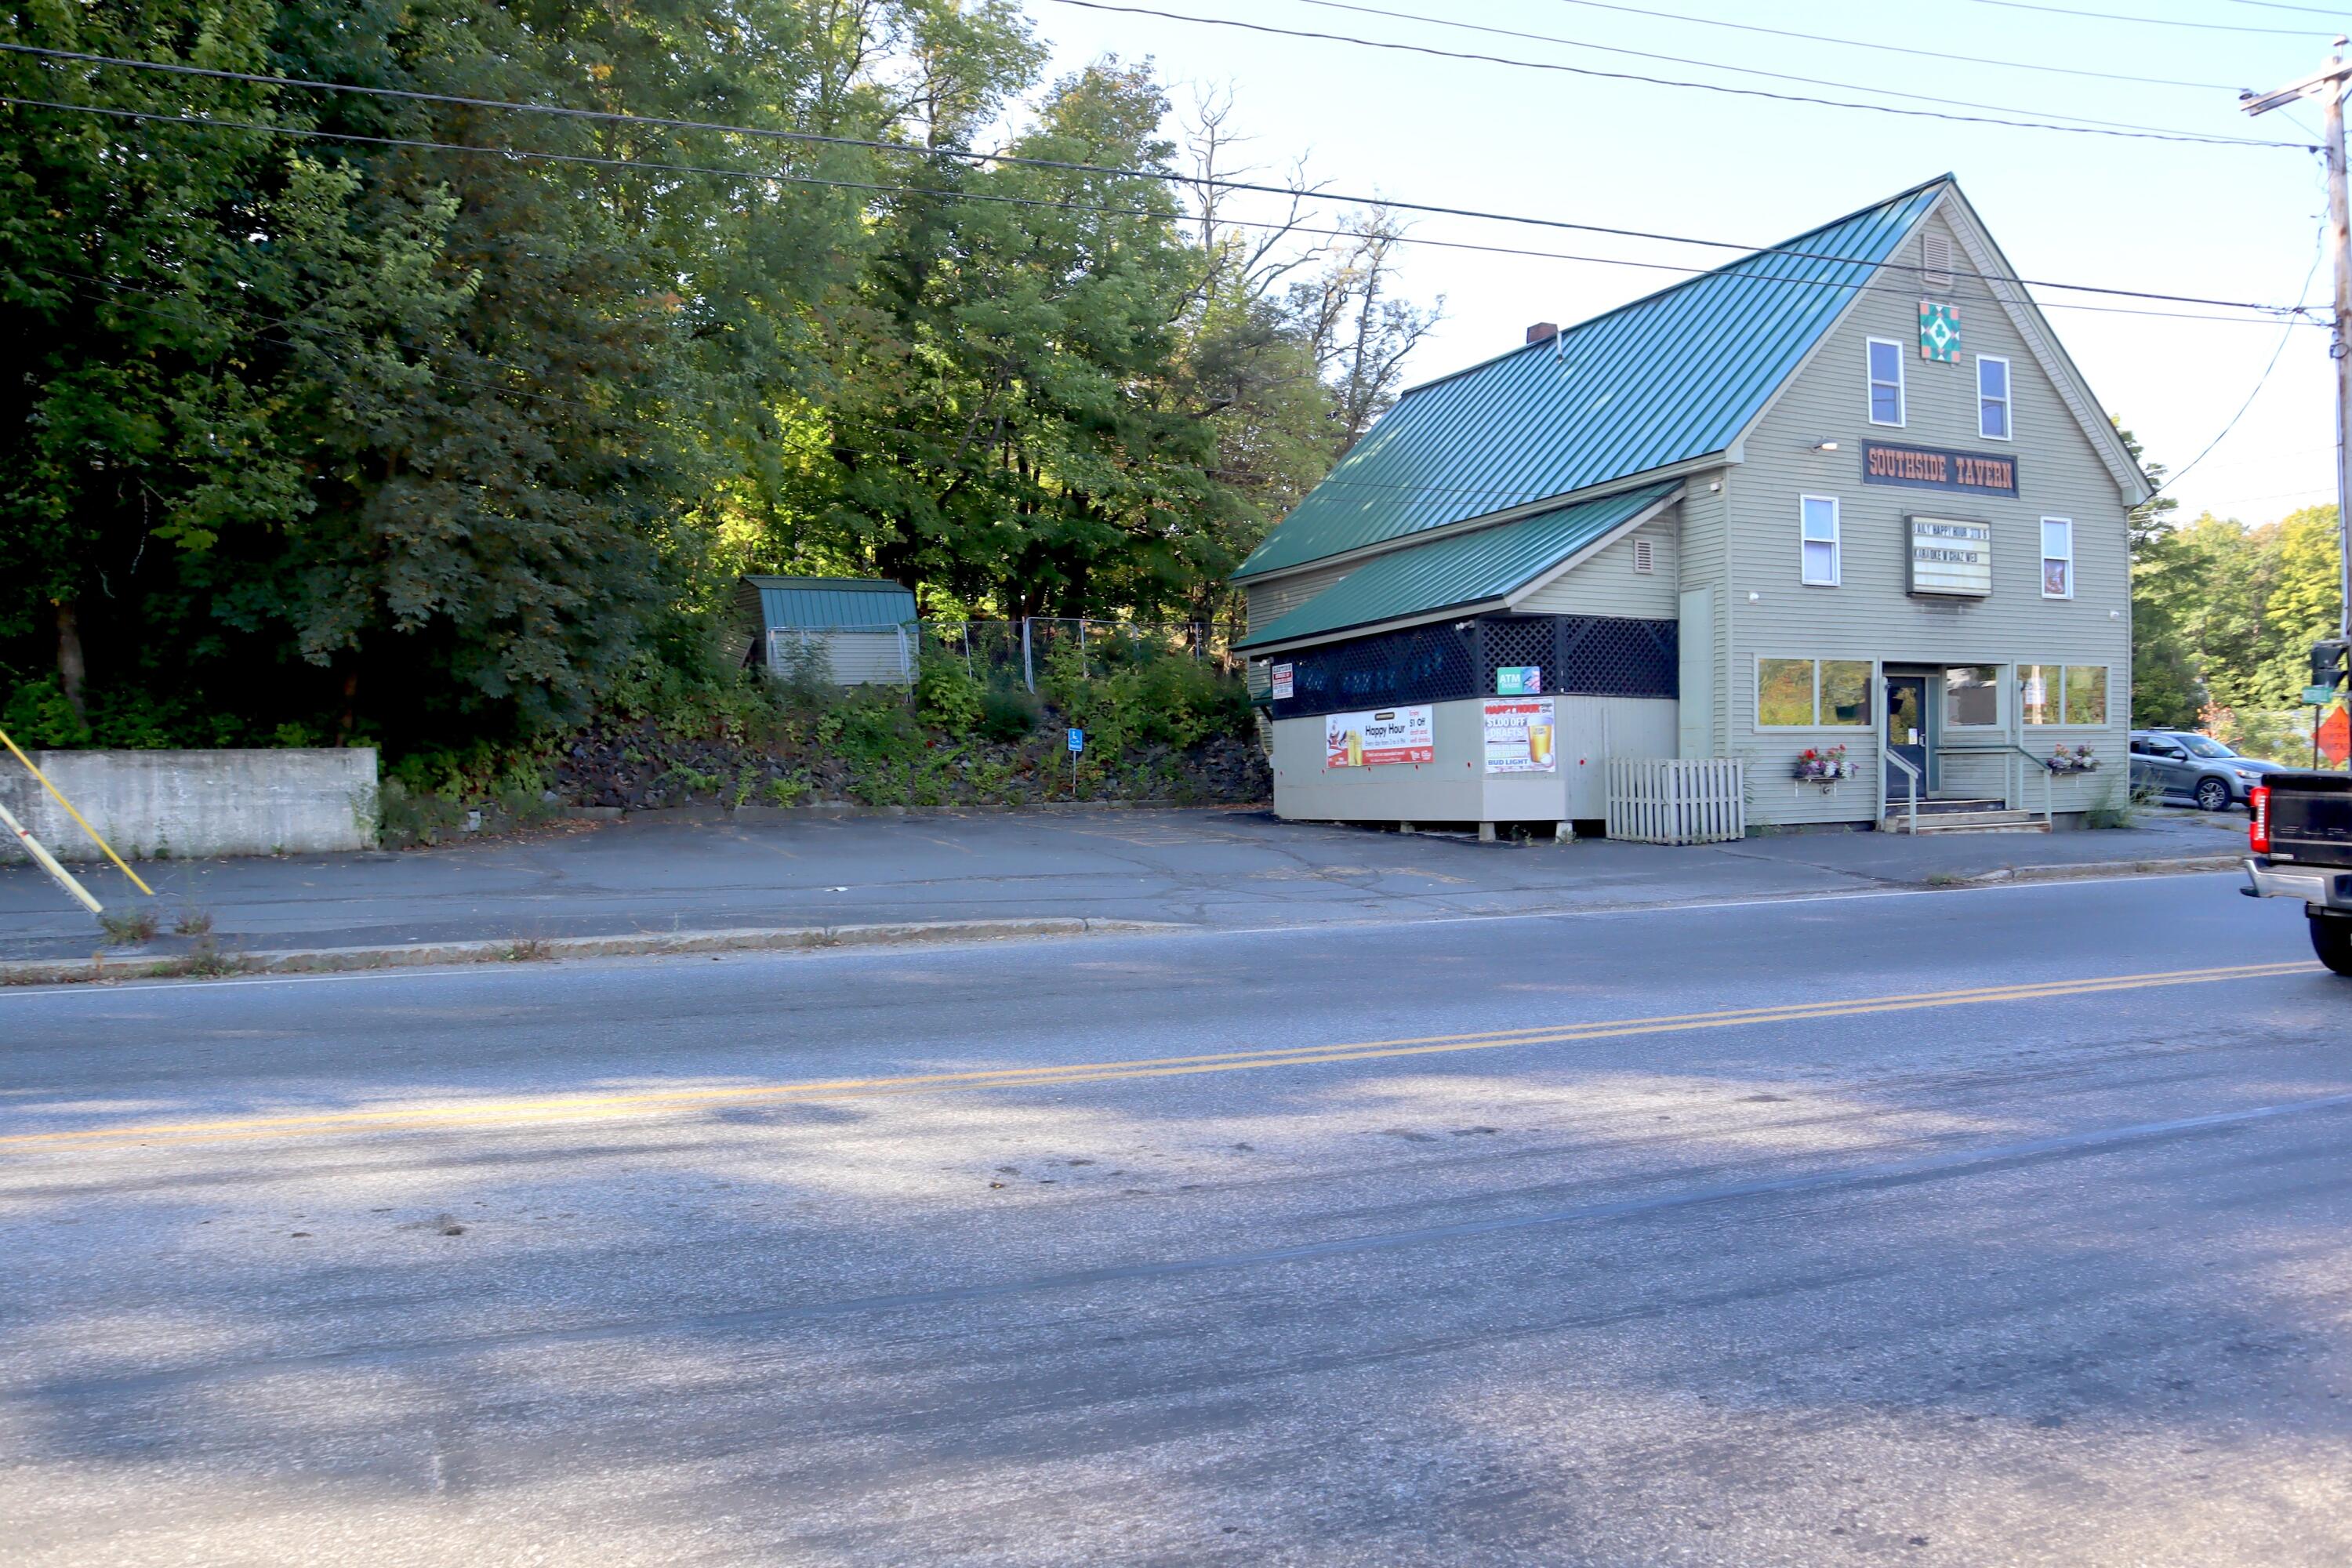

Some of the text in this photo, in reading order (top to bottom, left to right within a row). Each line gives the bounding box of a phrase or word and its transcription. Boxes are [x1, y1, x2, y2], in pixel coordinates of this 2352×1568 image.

[1868, 447, 2013, 489] SOUTHSIDE TAVERN
[1933, 524, 1951, 537] HAPPY
[1953, 527, 1967, 538] HOUR
[1914, 548, 1941, 561] KARAOKE
[1950, 550, 1964, 562] CHAZ
[1966, 551, 1978, 563] WED
[1500, 673, 1521, 684] ATM
[1484, 705, 1513, 714] HAPPY
[1417, 717, 1426, 726] Off
[1510, 717, 1526, 727] OFF
[1365, 723, 1406, 738] Happy Hour
[1490, 728, 1523, 738] DRAFTS
